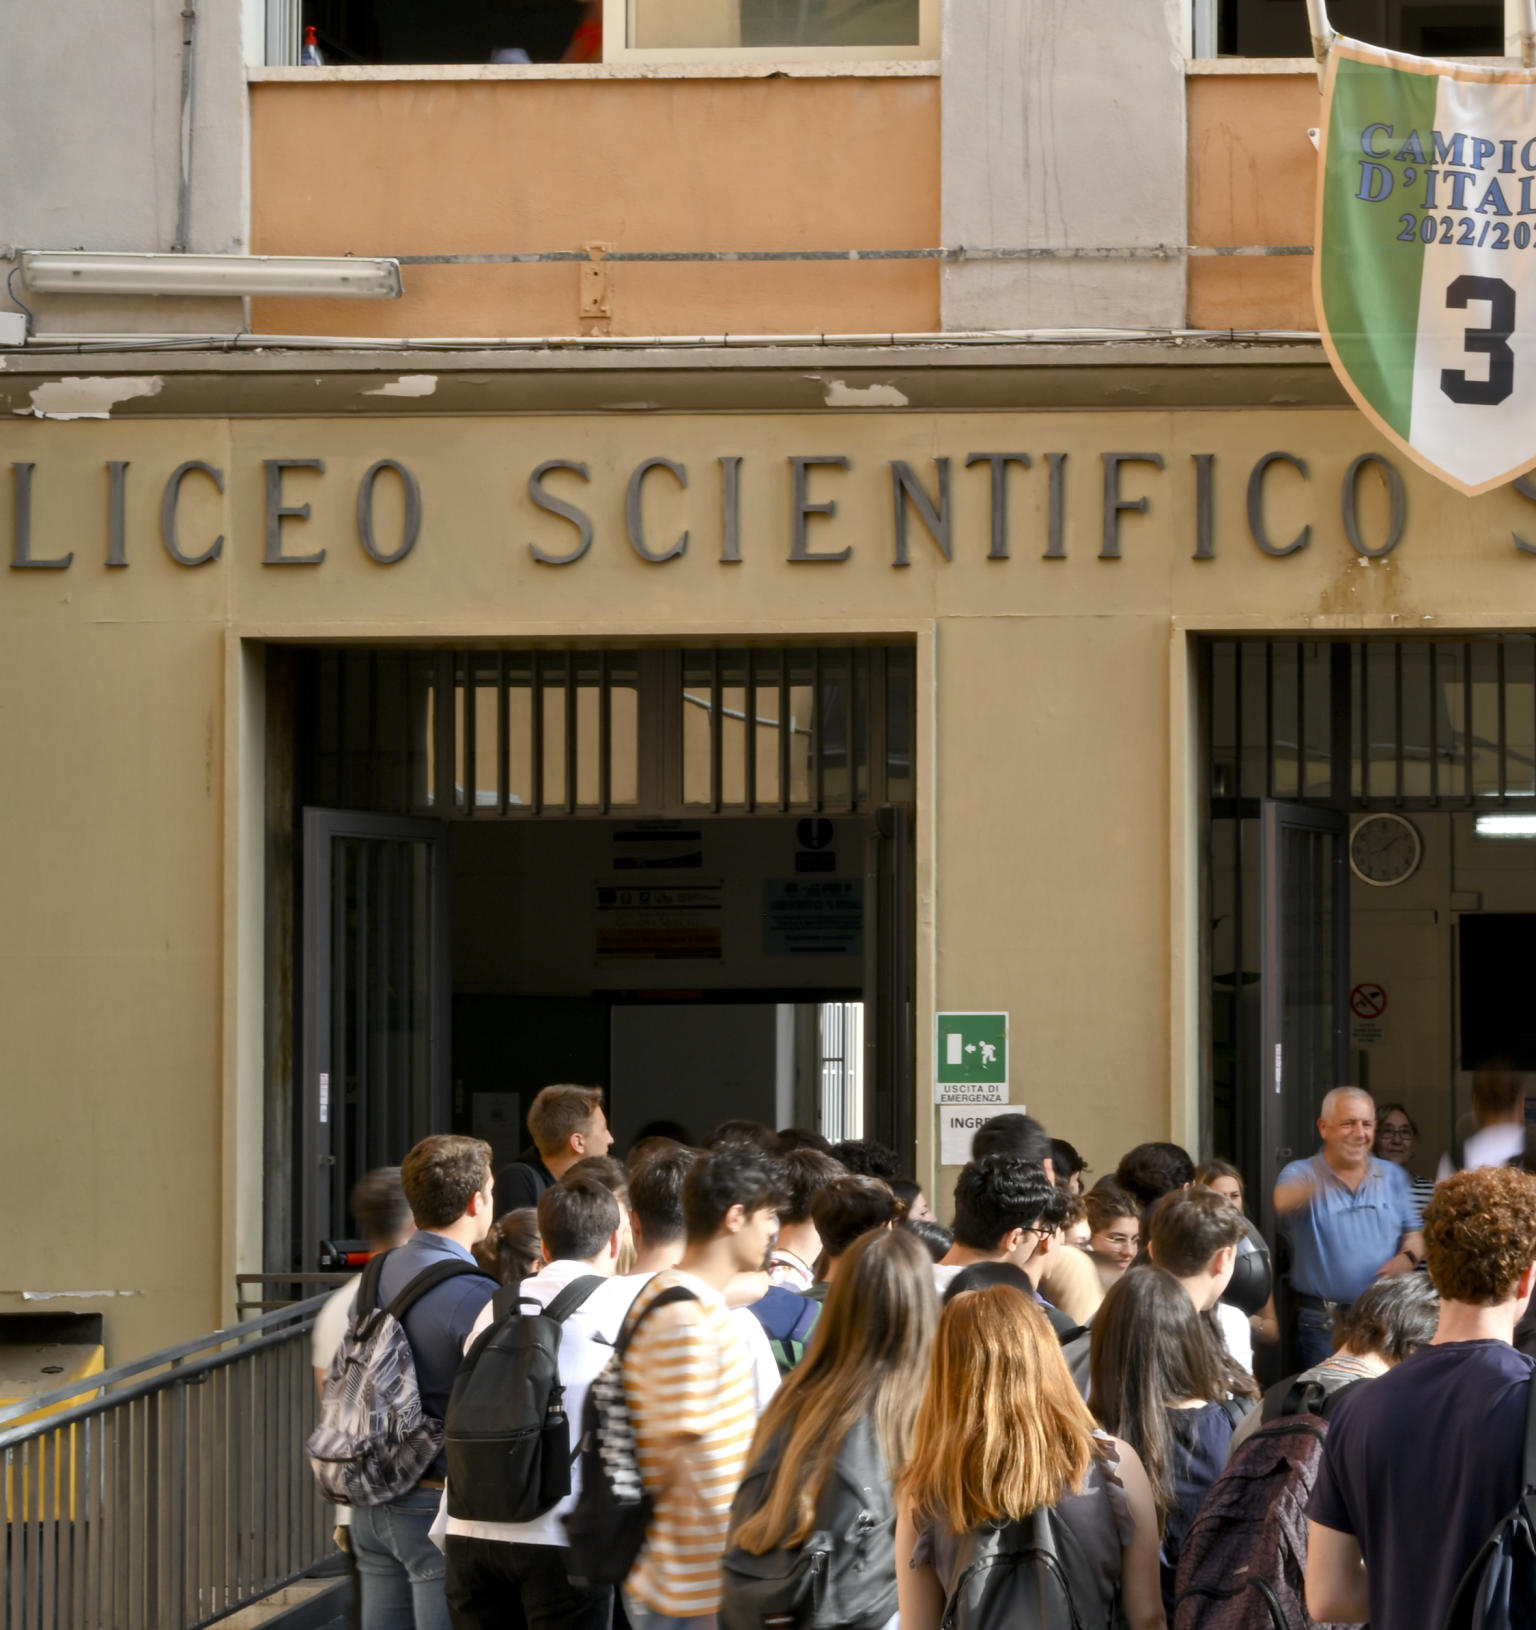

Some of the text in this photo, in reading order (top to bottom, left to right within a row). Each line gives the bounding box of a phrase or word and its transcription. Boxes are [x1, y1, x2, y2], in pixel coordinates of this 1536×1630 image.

[1439, 274, 1517, 406] 3
[9, 457, 423, 570] LICEO
[527, 450, 1408, 567] SCIENTIFICO
[943, 1085, 999, 1093] USCITA DI
[940, 1093, 1002, 1103] EMERGENZA
[950, 1117, 992, 1129] INGR
